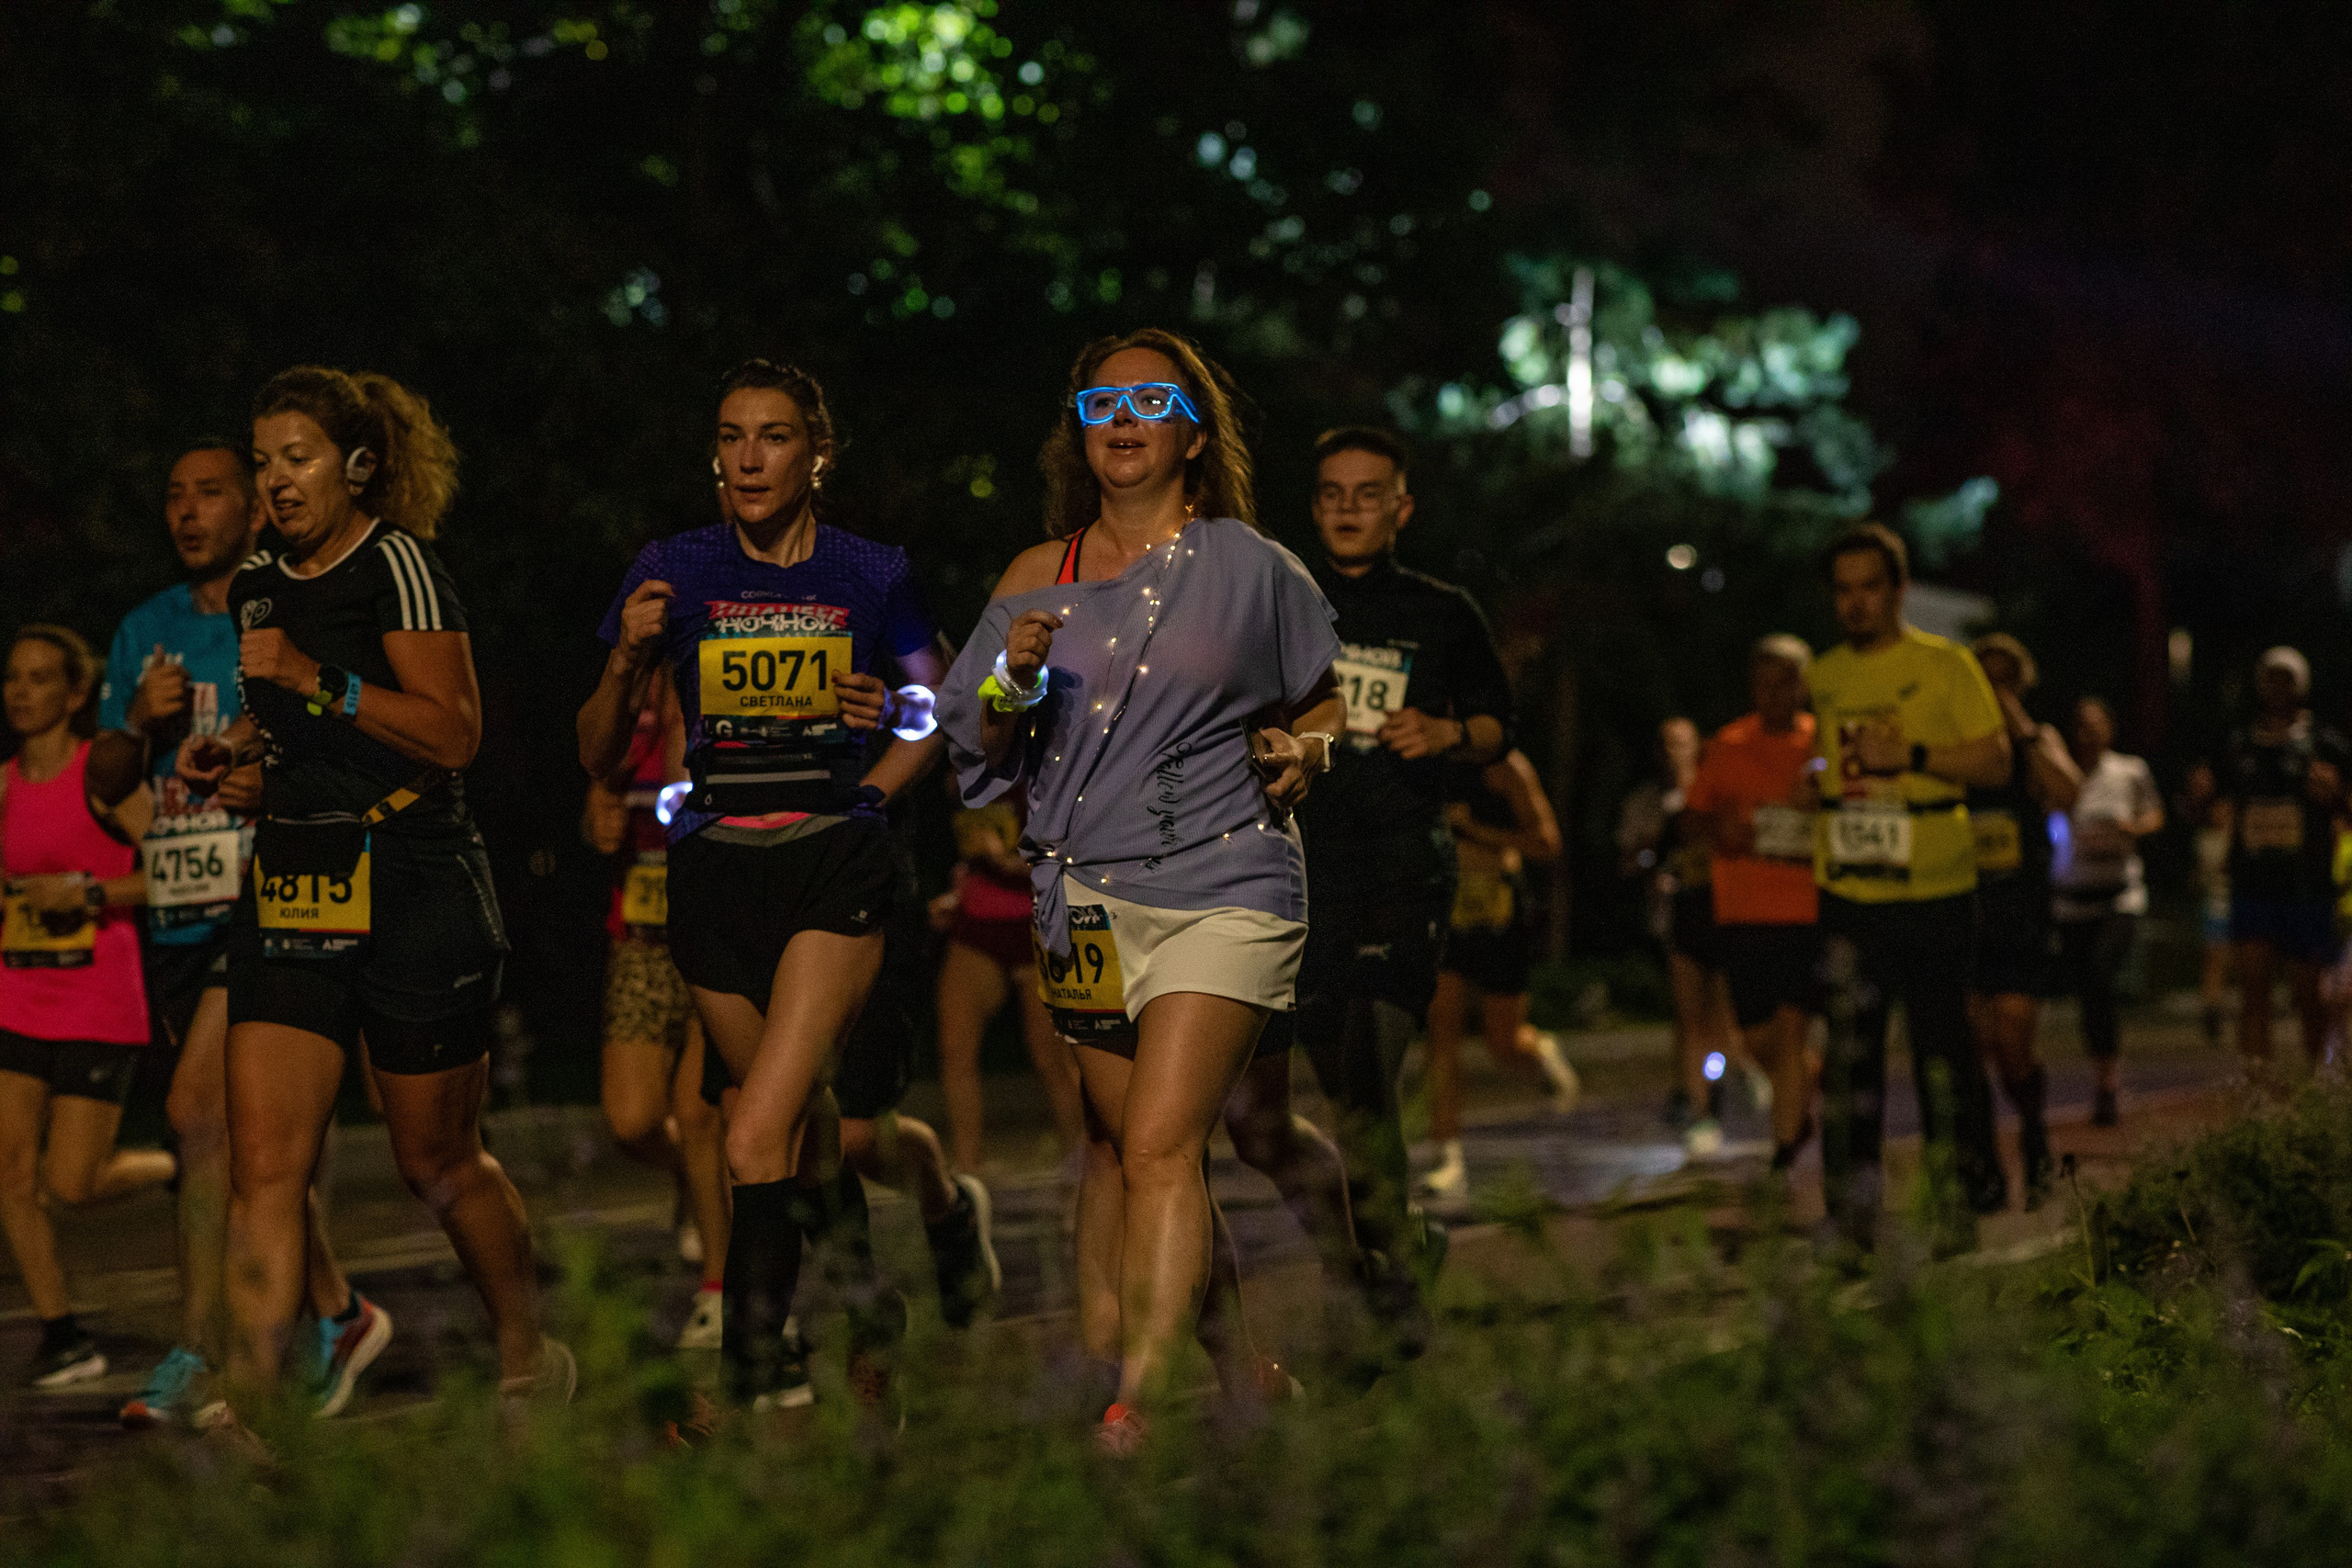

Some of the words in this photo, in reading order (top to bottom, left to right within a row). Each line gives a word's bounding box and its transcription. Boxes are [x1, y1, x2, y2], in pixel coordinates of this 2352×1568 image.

[722, 649, 827, 691] 5071
[741, 695, 813, 707] СВЕТЛАНА
[1338, 673, 1387, 711] 18
[153, 841, 223, 882] 4756
[260, 874, 353, 904] 4815
[279, 908, 320, 919] ЮЛИЯ
